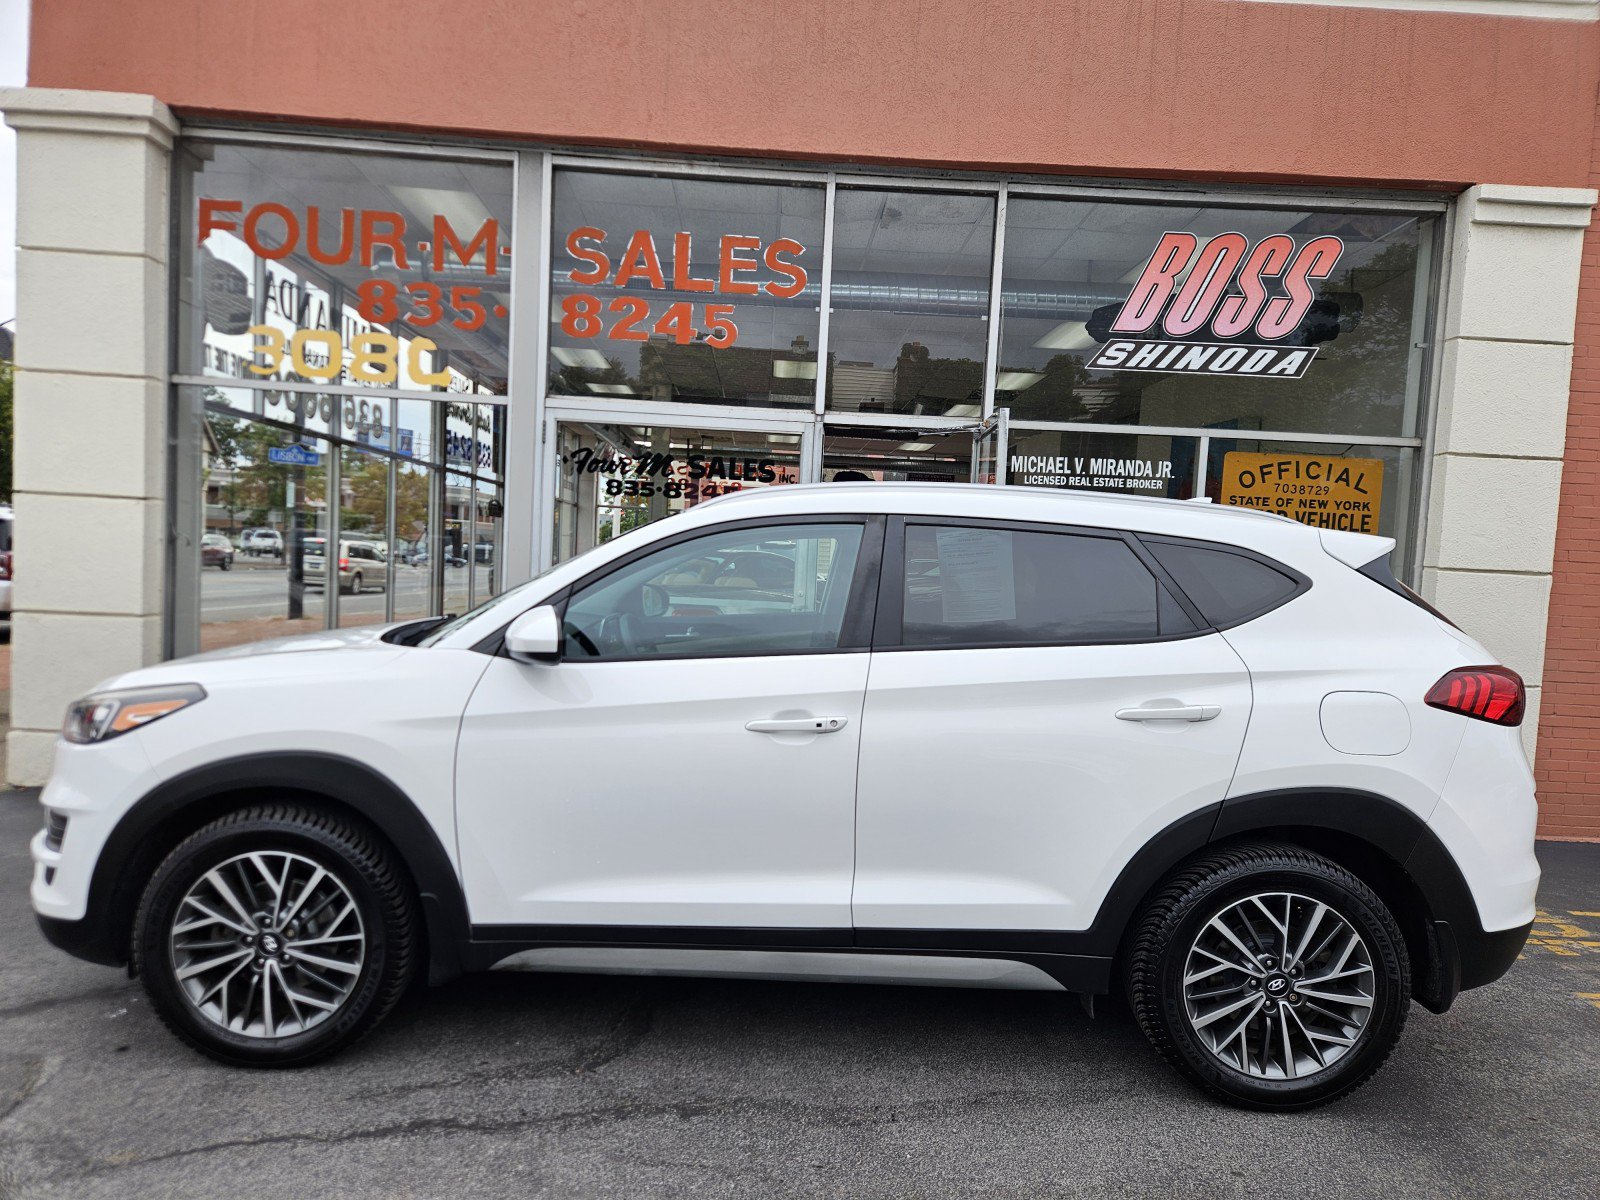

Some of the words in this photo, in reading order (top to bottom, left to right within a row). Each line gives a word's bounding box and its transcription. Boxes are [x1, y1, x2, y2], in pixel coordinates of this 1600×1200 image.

[566, 226, 808, 299] SALES
[1109, 231, 1345, 340] BOSS
[561, 293, 739, 349] 8245
[1096, 342, 1310, 376] SHINODA
[686, 454, 777, 484] SALES
[778, 474, 798, 485] INC.
[1011, 455, 1071, 474] MICHAEL
[1074, 457, 1086, 475] V.
[1090, 458, 1153, 478] MIRANDA
[1155, 460, 1175, 479] JR.
[1024, 475, 1067, 486] LICENSED
[1068, 477, 1091, 487] REAL
[1093, 478, 1125, 488] ESTATE
[1126, 479, 1163, 490] BROKER
[1238, 460, 1369, 496] OFFICIAL
[1229, 494, 1270, 507] STATE
[1275, 497, 1294, 508] OF
[1299, 498, 1331, 510] NEW
[1334, 500, 1371, 512] YORK
[1274, 483, 1331, 496] 7038729
[1294, 510, 1372, 533] VEHICLE
